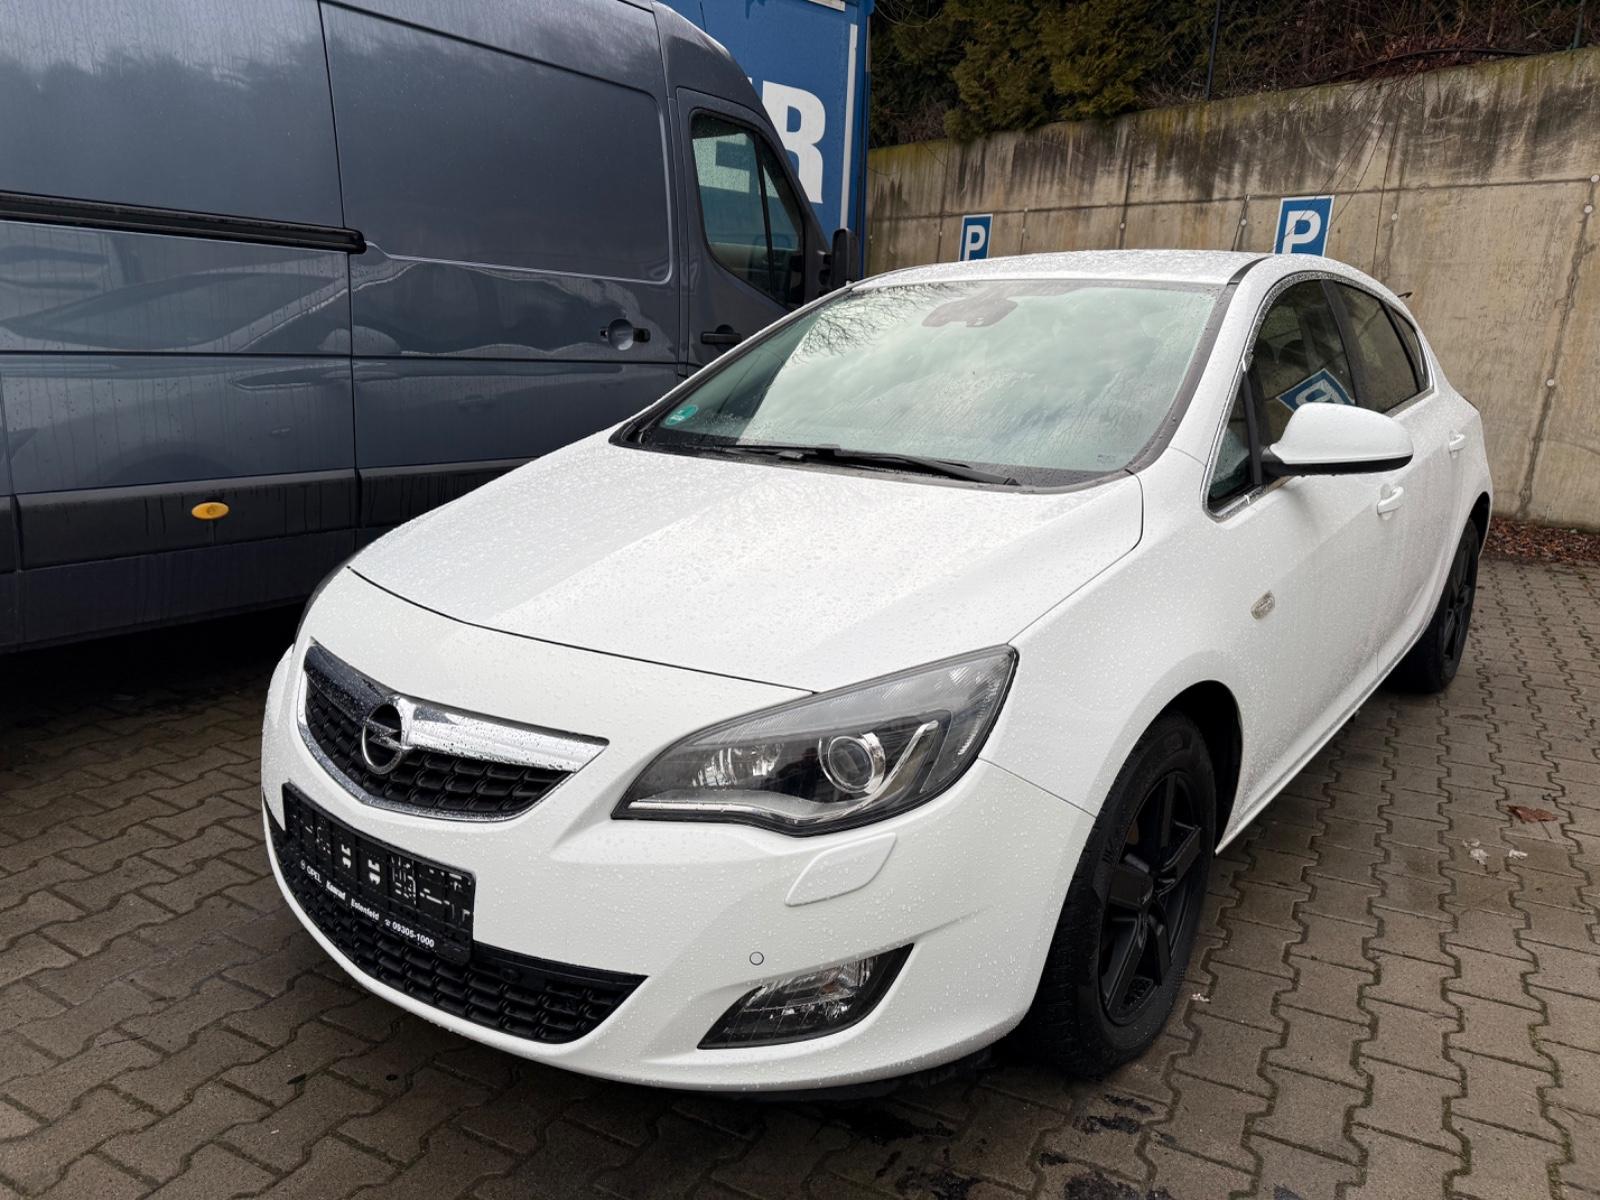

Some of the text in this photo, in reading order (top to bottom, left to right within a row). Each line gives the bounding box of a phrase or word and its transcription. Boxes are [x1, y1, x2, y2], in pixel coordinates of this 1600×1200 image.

[964, 224, 986, 261] P
[1281, 209, 1321, 254] P
[306, 865, 322, 883] OPEL
[392, 921, 435, 948] 09305-1000
